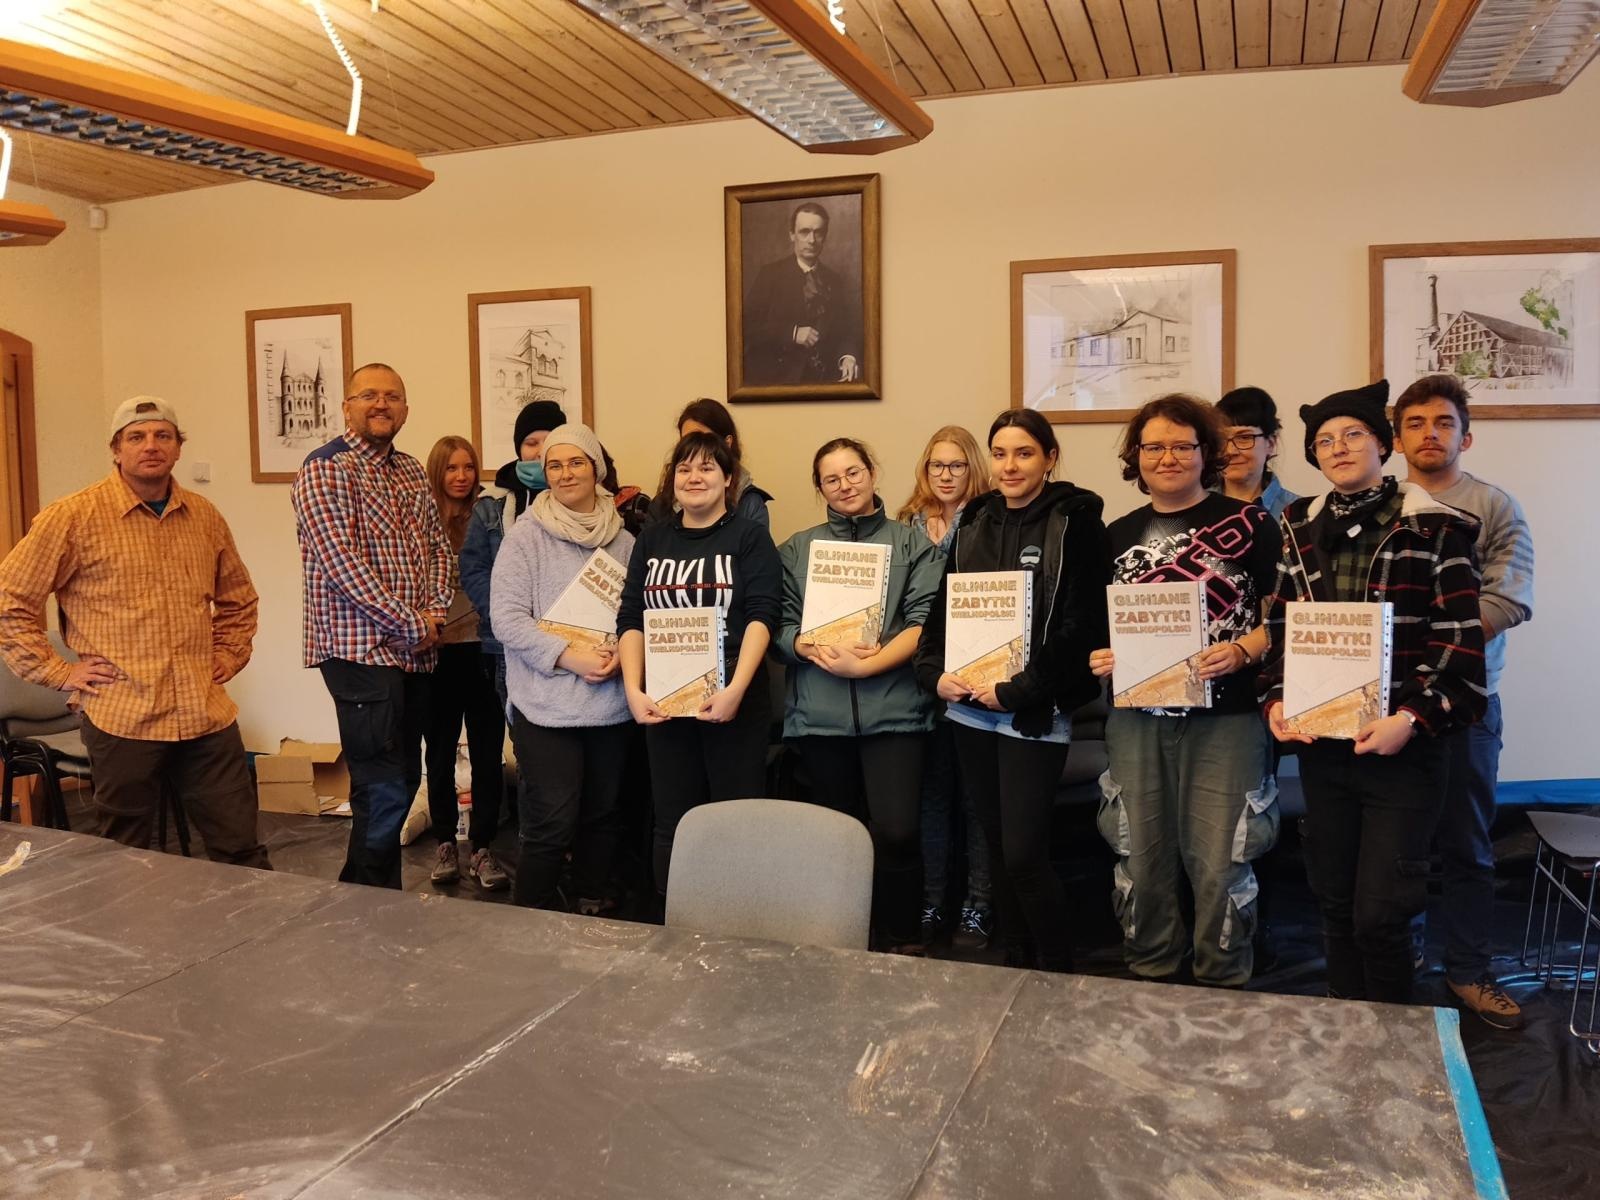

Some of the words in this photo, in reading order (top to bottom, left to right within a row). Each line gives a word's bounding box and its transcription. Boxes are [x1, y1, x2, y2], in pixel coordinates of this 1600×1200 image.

[814, 549, 878, 564] GLINIANE
[812, 563, 876, 578] ZABYTKI
[951, 580, 1017, 593] GLINIANE
[951, 596, 1016, 609] ZABYTKI
[1113, 592, 1191, 606] GLINIANE
[648, 616, 709, 629] GLINIANE
[1114, 610, 1191, 624] ZABYTKI
[1292, 612, 1373, 626] GLINIANE
[1115, 625, 1192, 634] WIELKOPOLSKI
[648, 632, 709, 644] ZABYTKI
[1291, 629, 1372, 646] ZABYTKI
[1291, 646, 1372, 657] WIELKOPOLSKI
